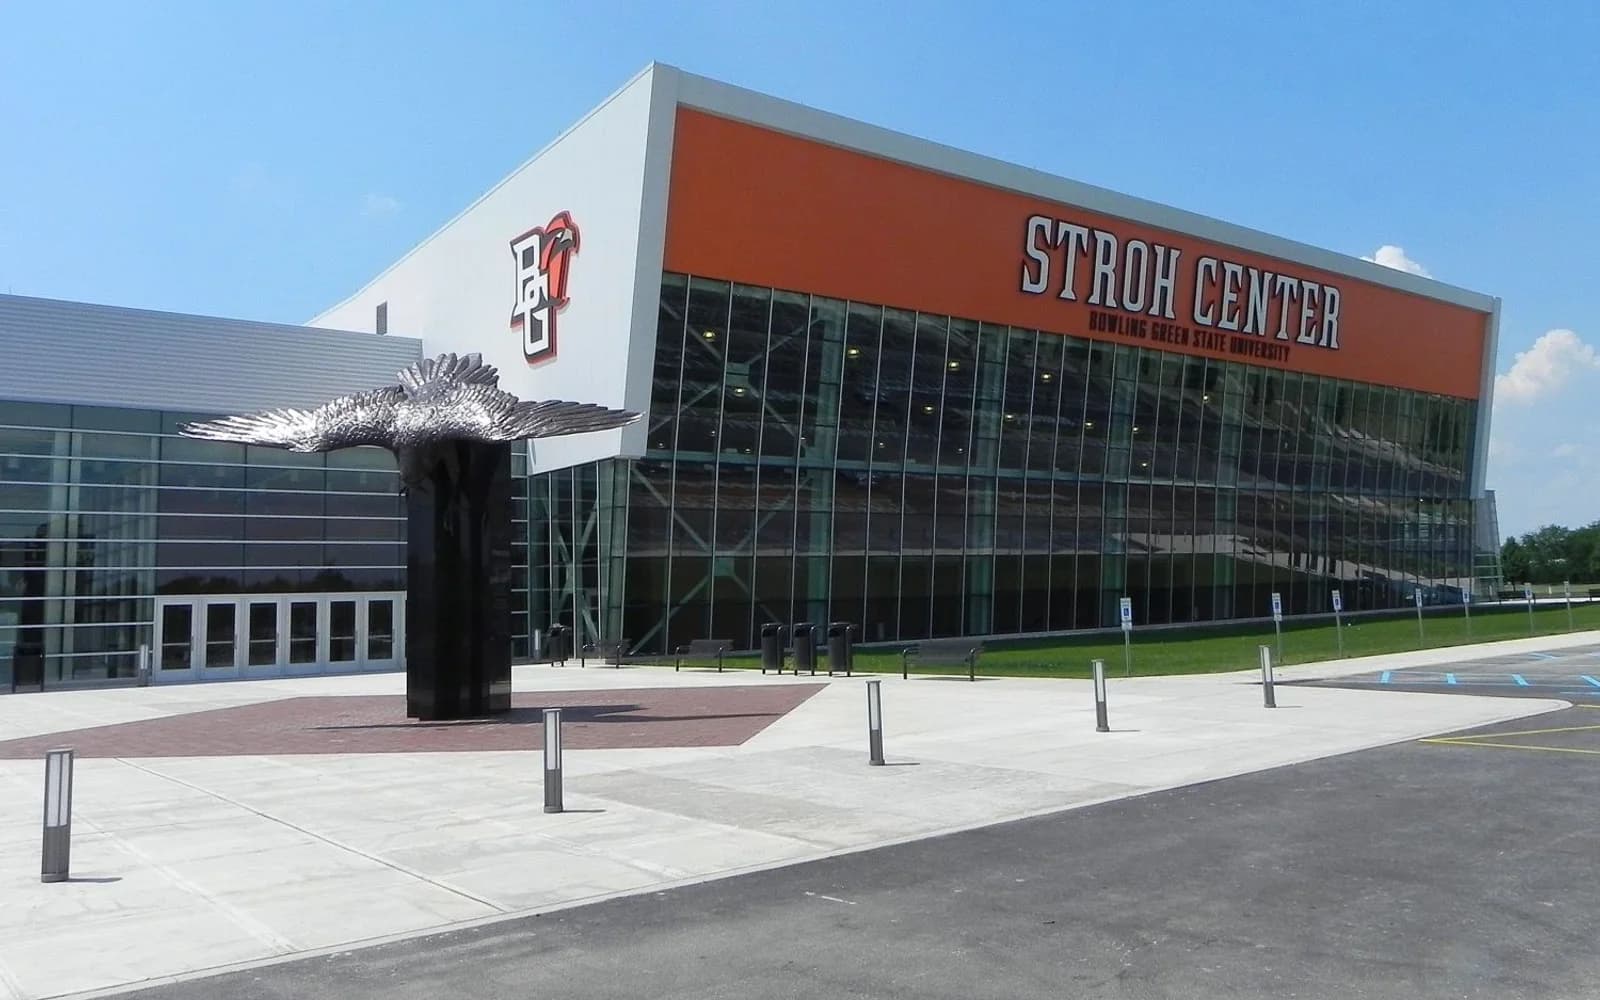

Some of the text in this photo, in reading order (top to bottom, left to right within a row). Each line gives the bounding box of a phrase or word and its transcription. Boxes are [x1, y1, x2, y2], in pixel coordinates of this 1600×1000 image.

[1021, 214, 1341, 349] STROH CENTER
[1089, 311, 1290, 362] BOWLING GREEN STATE UNIVERSITY
